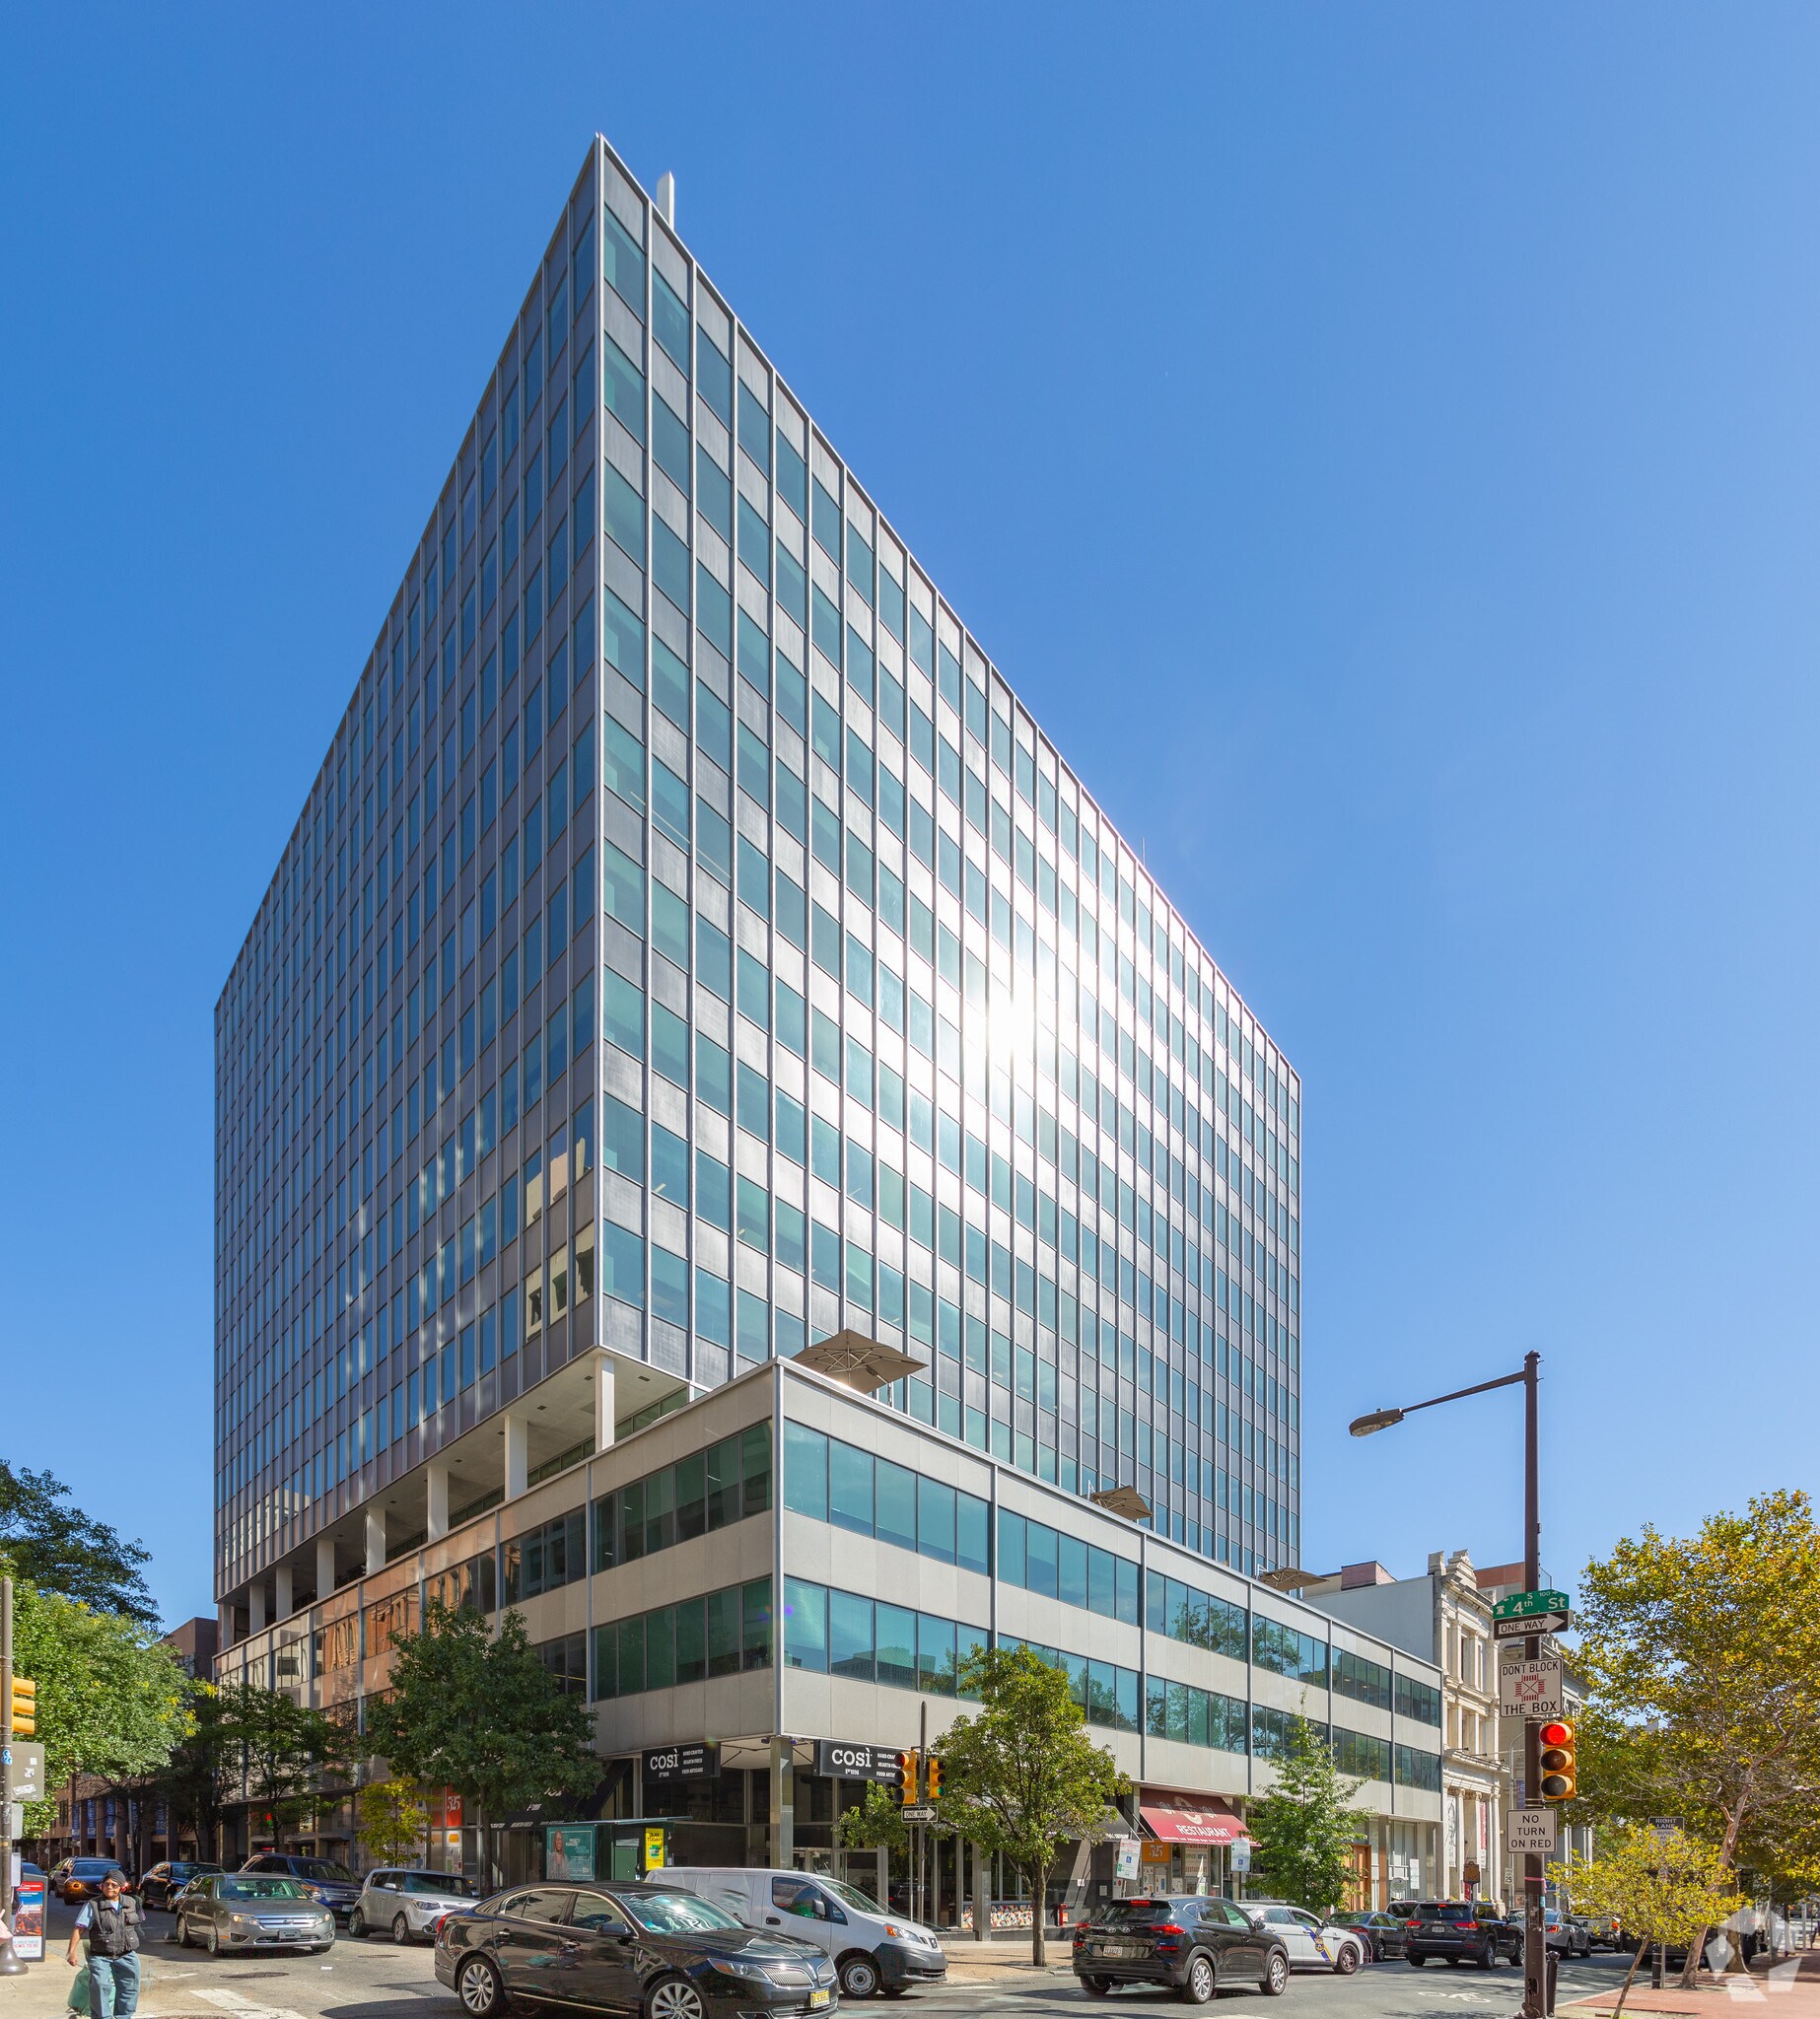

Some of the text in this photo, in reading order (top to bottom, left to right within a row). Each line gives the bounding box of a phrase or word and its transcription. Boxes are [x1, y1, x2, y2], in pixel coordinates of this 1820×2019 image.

[1512, 1597, 1566, 1614] 4th St
[1501, 1619, 1546, 1634] ONE WAY
[1529, 1660, 1559, 1673] BLOCK
[1504, 1701, 1557, 1715] THE BOX
[1522, 1814, 1540, 1824] NO
[1175, 1824, 1232, 1838] RESTAURANT
[1516, 1827, 1546, 1836] TURN
[1510, 1840, 1552, 1848] ON RED
[1149, 1845, 1163, 1858] 525
